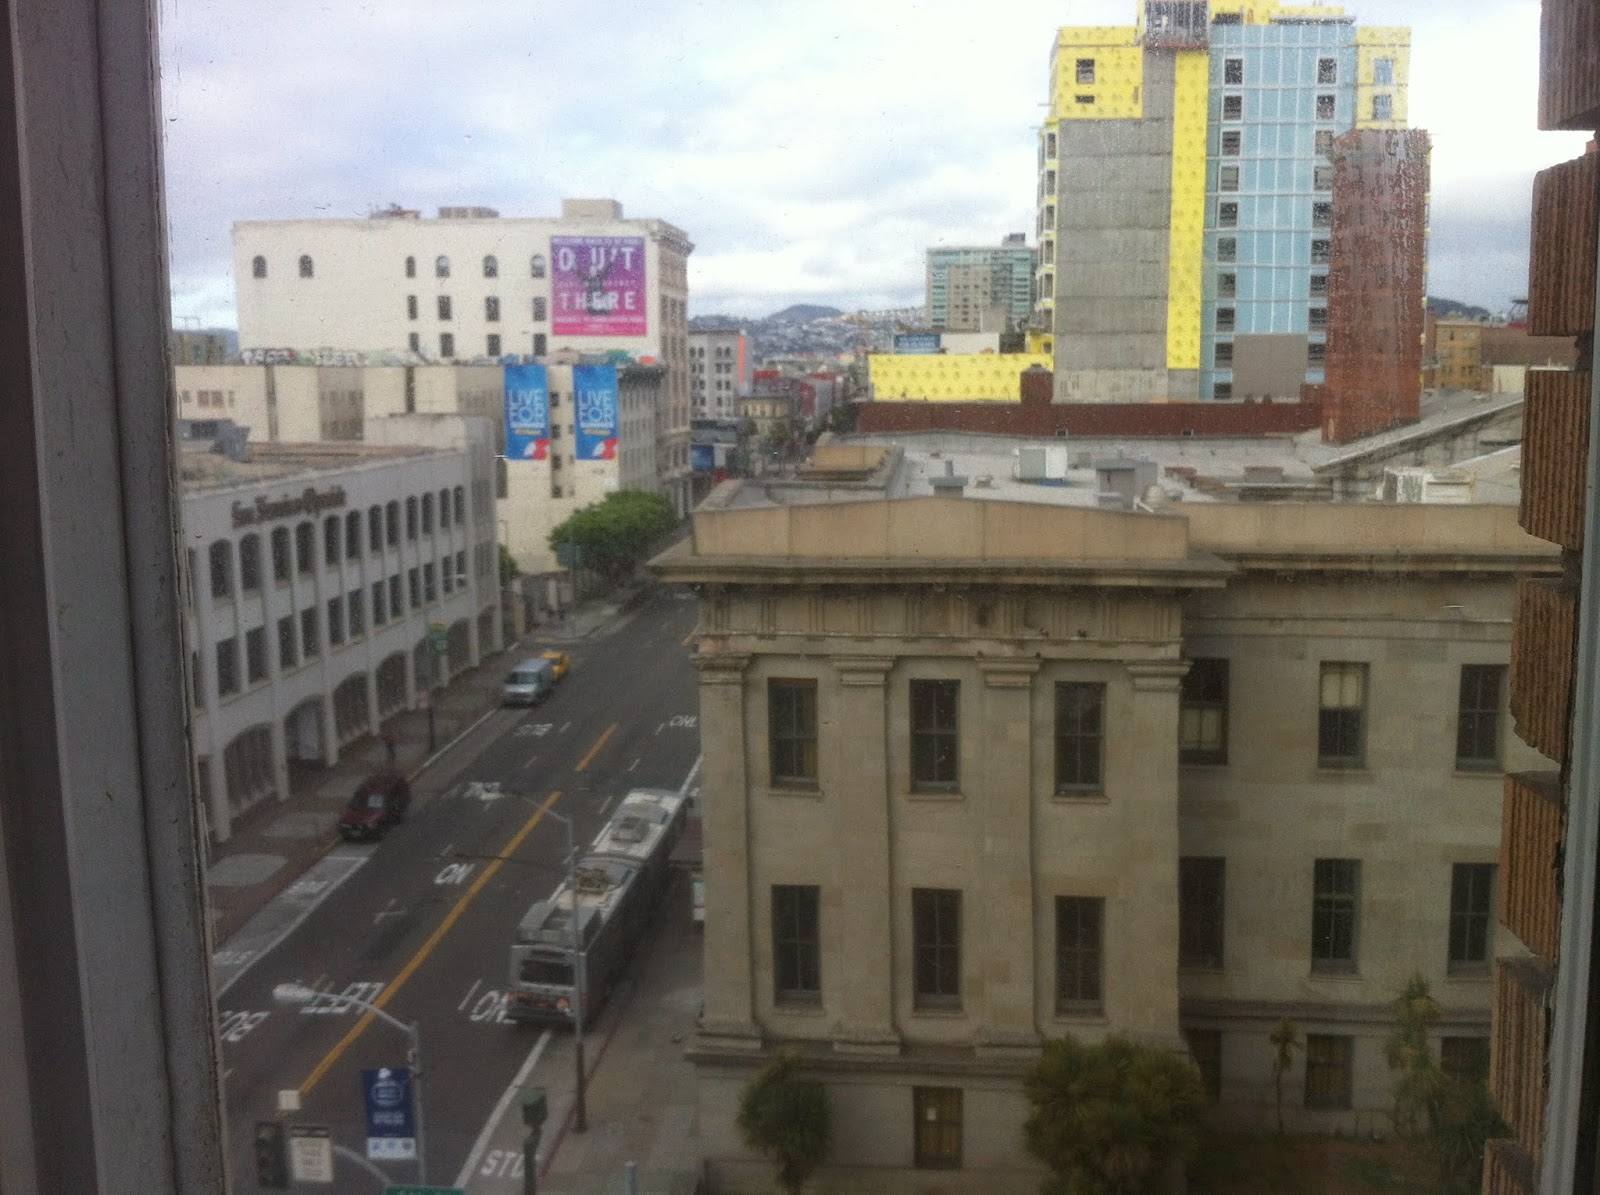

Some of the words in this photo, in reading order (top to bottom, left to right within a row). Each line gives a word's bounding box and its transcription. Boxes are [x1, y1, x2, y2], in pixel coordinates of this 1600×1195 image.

[559, 291, 637, 311] THERE
[508, 389, 544, 405] LIVE
[577, 389, 613, 405] LIVE
[509, 404, 546, 422] FOR
[578, 404, 615, 422] FOR
